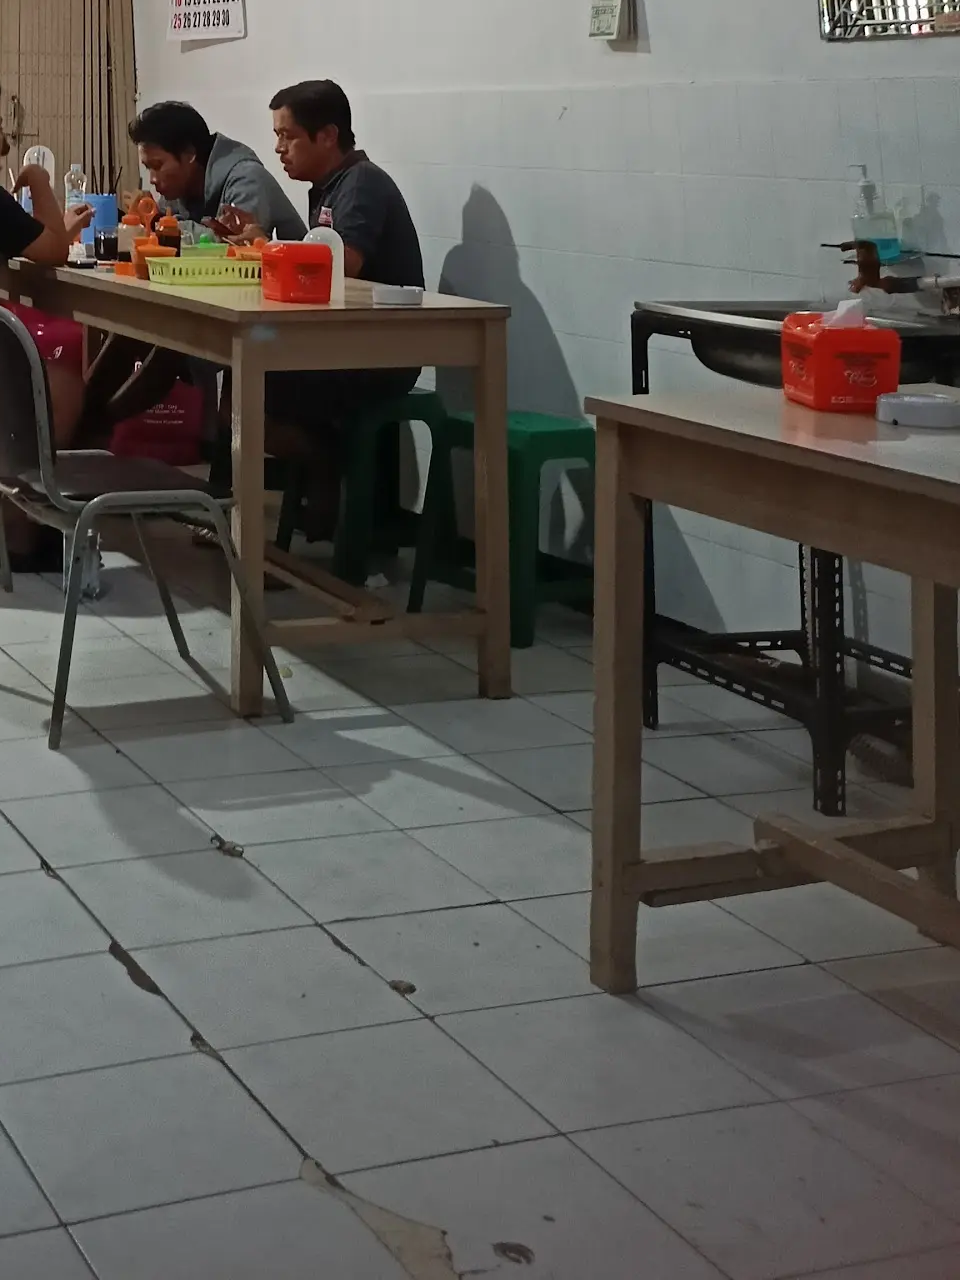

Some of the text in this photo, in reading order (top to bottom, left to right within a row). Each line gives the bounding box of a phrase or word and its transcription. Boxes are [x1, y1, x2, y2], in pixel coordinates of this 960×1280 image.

[173, 9, 230, 29] 25 26 27 28 29 30
